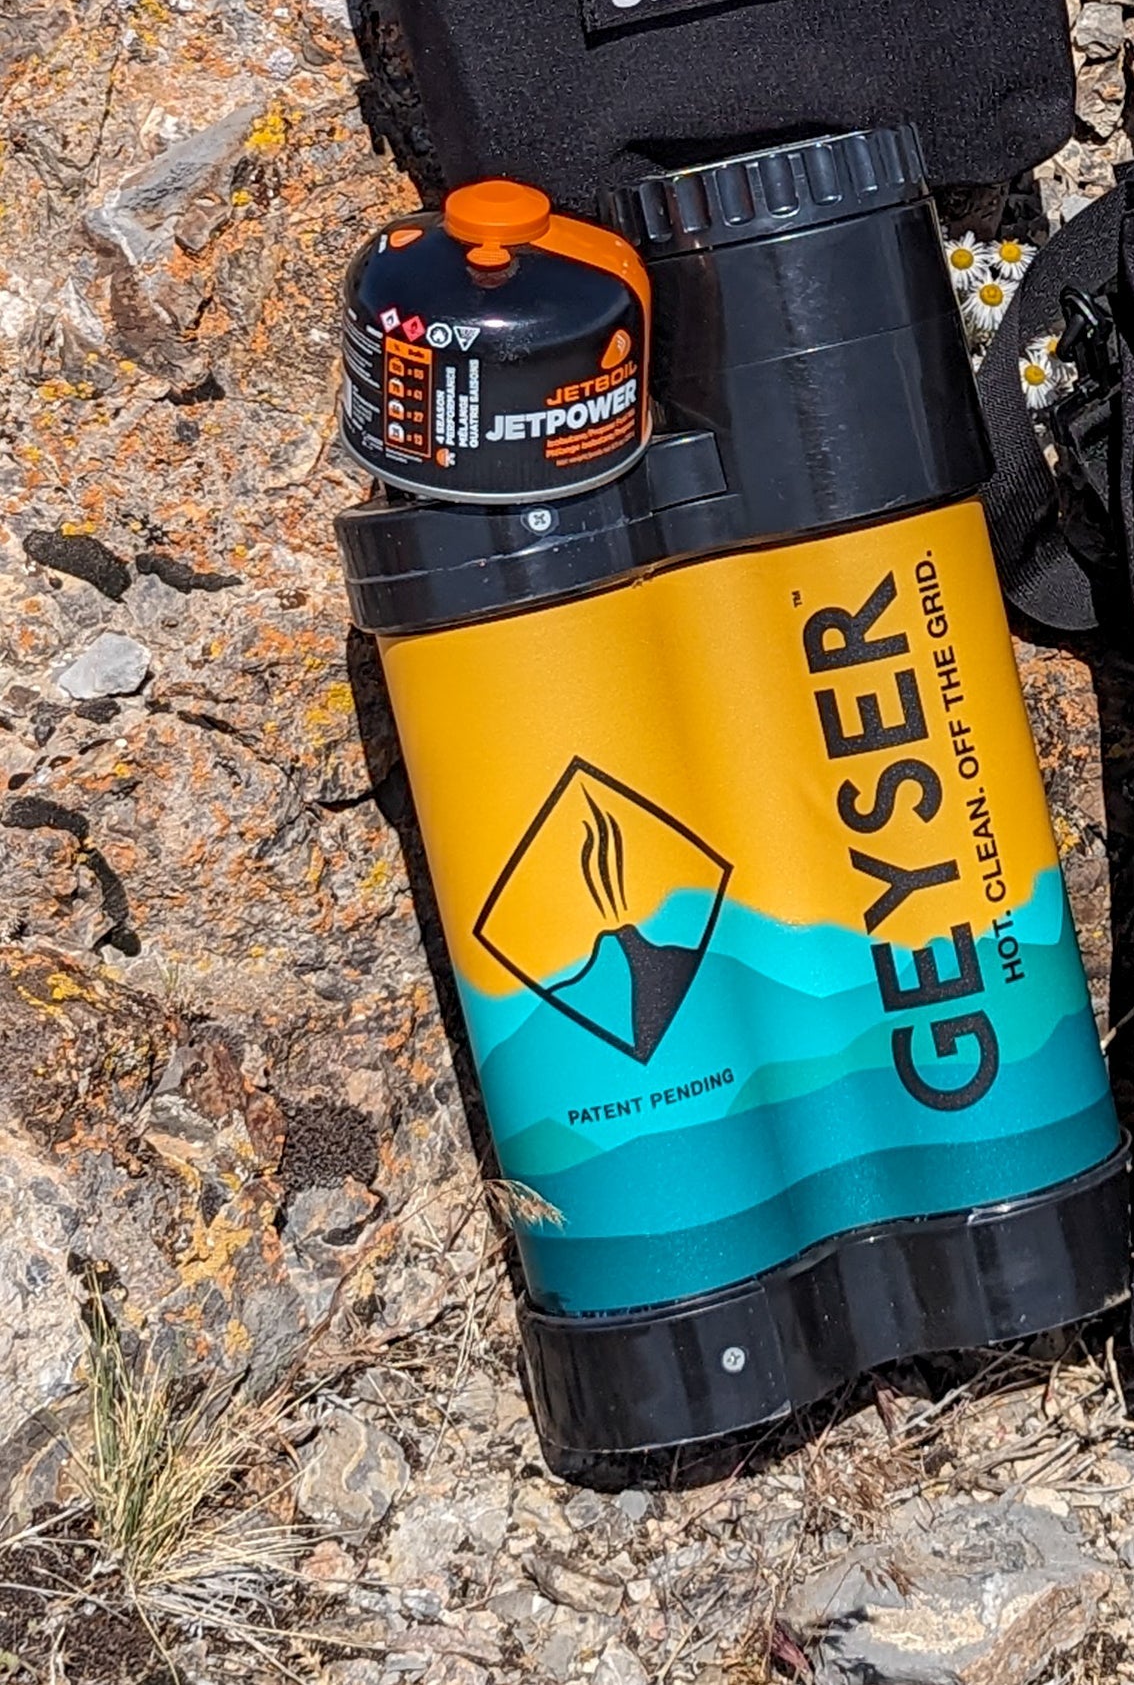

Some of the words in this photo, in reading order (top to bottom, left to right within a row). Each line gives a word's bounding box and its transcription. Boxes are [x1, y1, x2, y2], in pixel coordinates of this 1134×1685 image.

[485, 378, 637, 442] JETPOWER
[546, 360, 638, 406] JETBOIL
[915, 550, 949, 639] GRID.
[933, 645, 964, 712] THE
[949, 719, 979, 780] OFF
[803, 570, 1000, 1112] GEYSER
[966, 787, 1006, 903] CLEAN.
[992, 910, 1025, 984] HOT.
[568, 1097, 643, 1126] PATENT
[650, 1067, 735, 1109] PENDING
